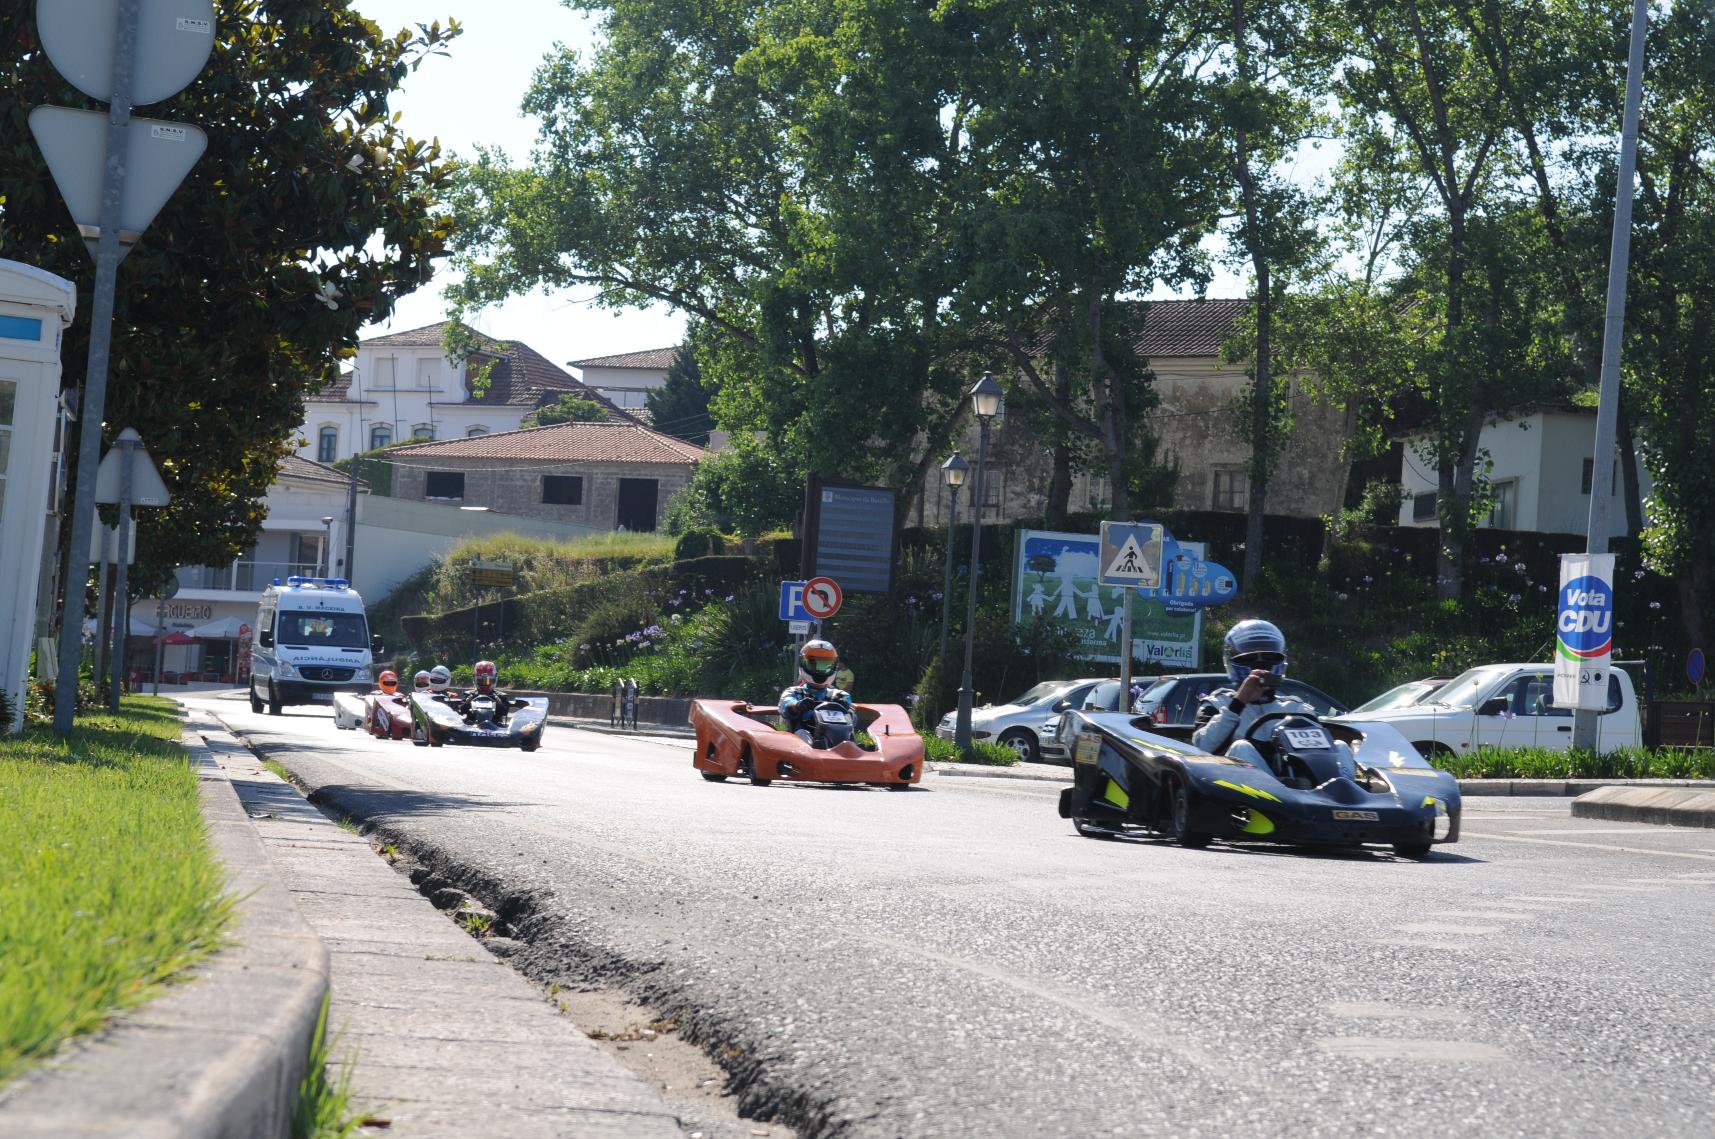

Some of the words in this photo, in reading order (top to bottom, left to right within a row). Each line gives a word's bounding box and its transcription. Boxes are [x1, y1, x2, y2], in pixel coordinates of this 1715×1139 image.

[1567, 588, 1606, 607] Vota
[1559, 610, 1611, 633] CDU
[1290, 730, 1322, 739] 103
[1334, 811, 1378, 820] GAS
